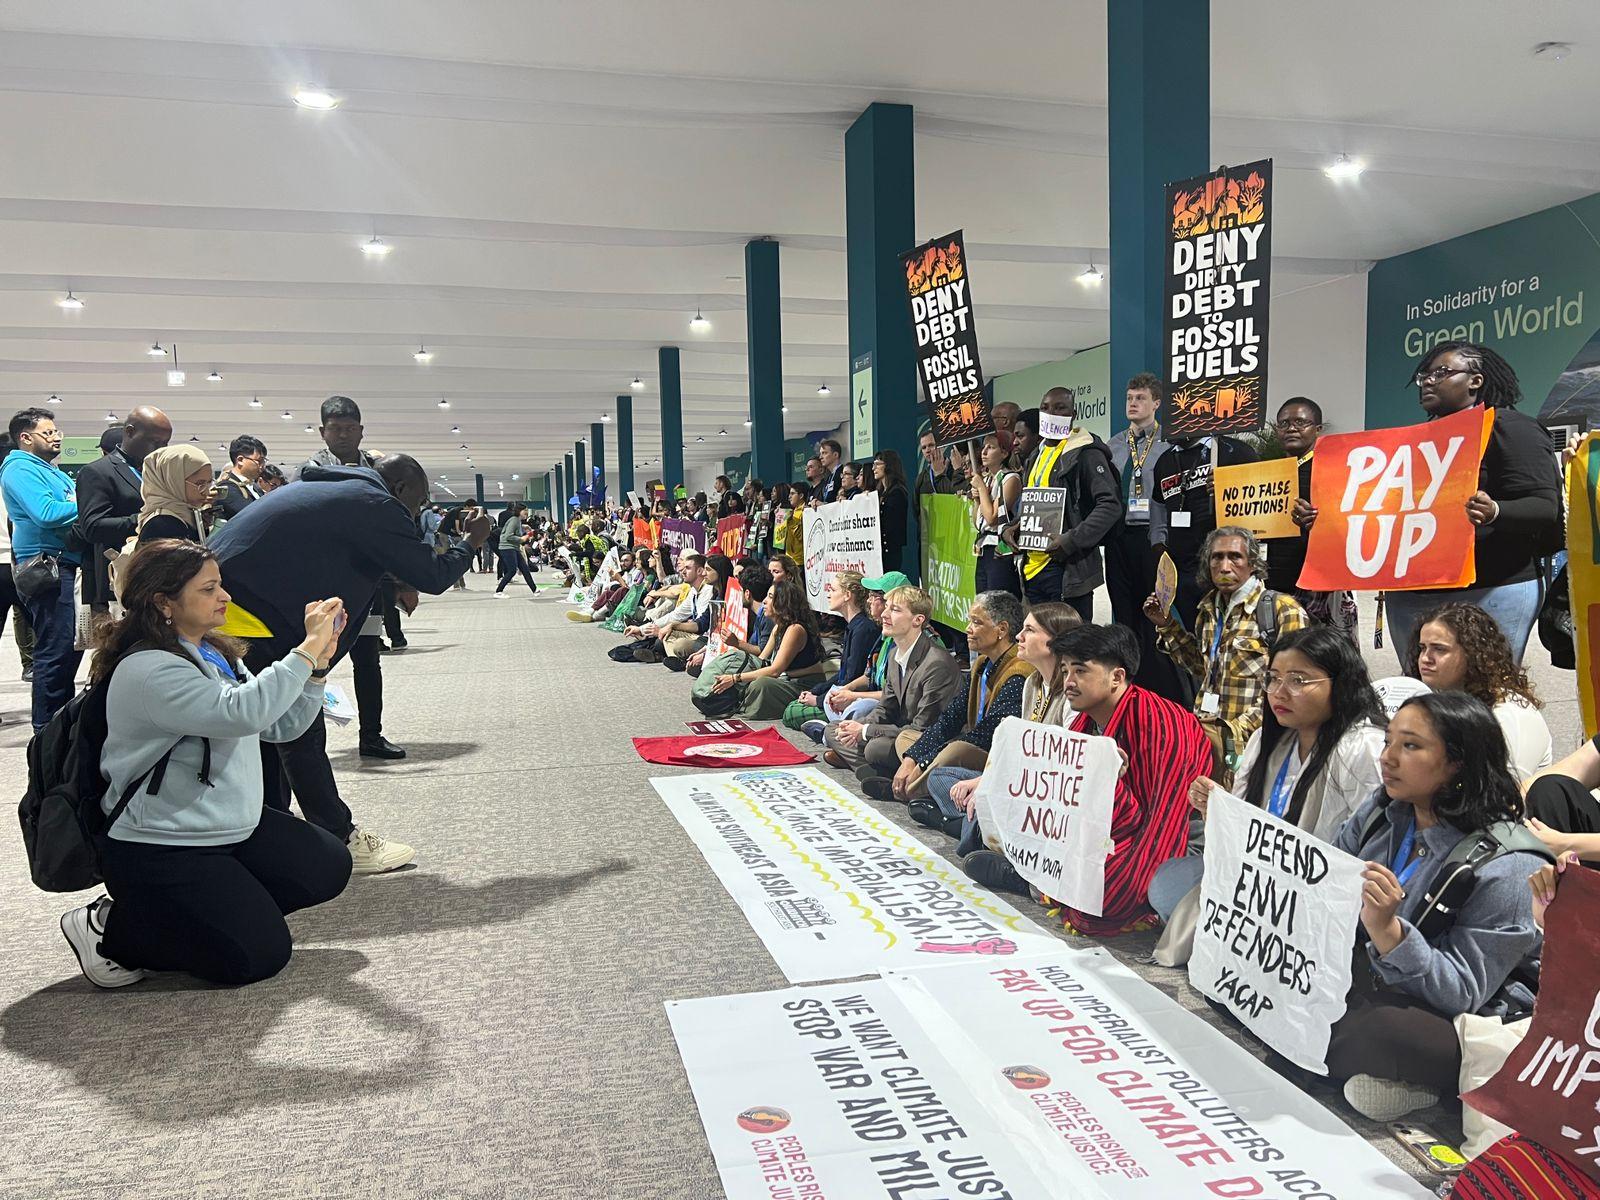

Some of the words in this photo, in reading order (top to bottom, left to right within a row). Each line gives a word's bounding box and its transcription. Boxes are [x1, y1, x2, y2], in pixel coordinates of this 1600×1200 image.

[1173, 223, 1265, 276] DENY
[1185, 263, 1246, 291] DIRTY
[1406, 303, 1420, 321] In
[1423, 284, 1497, 314] Solidarity
[1500, 279, 1526, 298] for
[1530, 275, 1540, 292] a
[911, 278, 965, 324] DENY
[1172, 279, 1260, 319] DEBT
[1201, 311, 1223, 325] TO
[1493, 291, 1584, 340] World
[915, 306, 969, 347] DEBT
[934, 336, 955, 353] TO
[1171, 316, 1260, 356] FOSSIL
[922, 344, 974, 381] FOSSIL
[1170, 345, 1259, 383] FUELS
[928, 368, 978, 403] FUELS
[1087, 384, 1092, 394] a
[1222, 486, 1239, 501] NO
[1241, 484, 1256, 499] TO
[1258, 479, 1291, 497] FALSE
[1340, 436, 1465, 513] PAY
[1020, 516, 1043, 532] EAL
[1029, 505, 1035, 514] A
[1224, 499, 1289, 518] SOLUTIONS!
[1019, 535, 1049, 547] UTION
[1345, 511, 1438, 579] UP
[1021, 727, 1087, 770] CLIMATE
[1008, 769, 1084, 807] JUSTICE
[1021, 805, 1068, 844] NOW!
[715, 823, 778, 870] SOUTHEAST
[753, 872, 799, 898] ASIA
[768, 804, 835, 843] CLIMATE
[814, 845, 953, 940] IMPERIALISM!
[807, 798, 880, 843] PLANET
[860, 845, 923, 879] OVER
[902, 880, 1002, 939] PROFIT!
[1246, 818, 1329, 885] DEFEND
[1233, 862, 1298, 936] ENVI
[1203, 897, 1316, 995] DEFENDERS
[988, 968, 1048, 994] PAY
[1213, 965, 1275, 1019] YACAP
[782, 998, 843, 1041] STOP
[831, 994, 875, 1017] WE
[1021, 998, 1075, 1022] UP
[849, 1017, 910, 1060] WANT
[1047, 1025, 1121, 1065] FOR
[811, 1045, 873, 1090] WAR
[1036, 964, 1085, 993] HOLD
[1069, 995, 1176, 1067] IMPERIALIST
[1156, 1069, 1285, 1164] POLLUTERS
[837, 1097, 908, 1142] AND
[880, 1066, 968, 1143] CLIMATE
[1096, 1069, 1237, 1168] CLIMATE
[1063, 1133, 1118, 1176] JUSTICE
[1089, 1132, 1137, 1168] RISING
[869, 1150, 949, 1200] MIL
[1204, 1176, 1278, 1200] D
